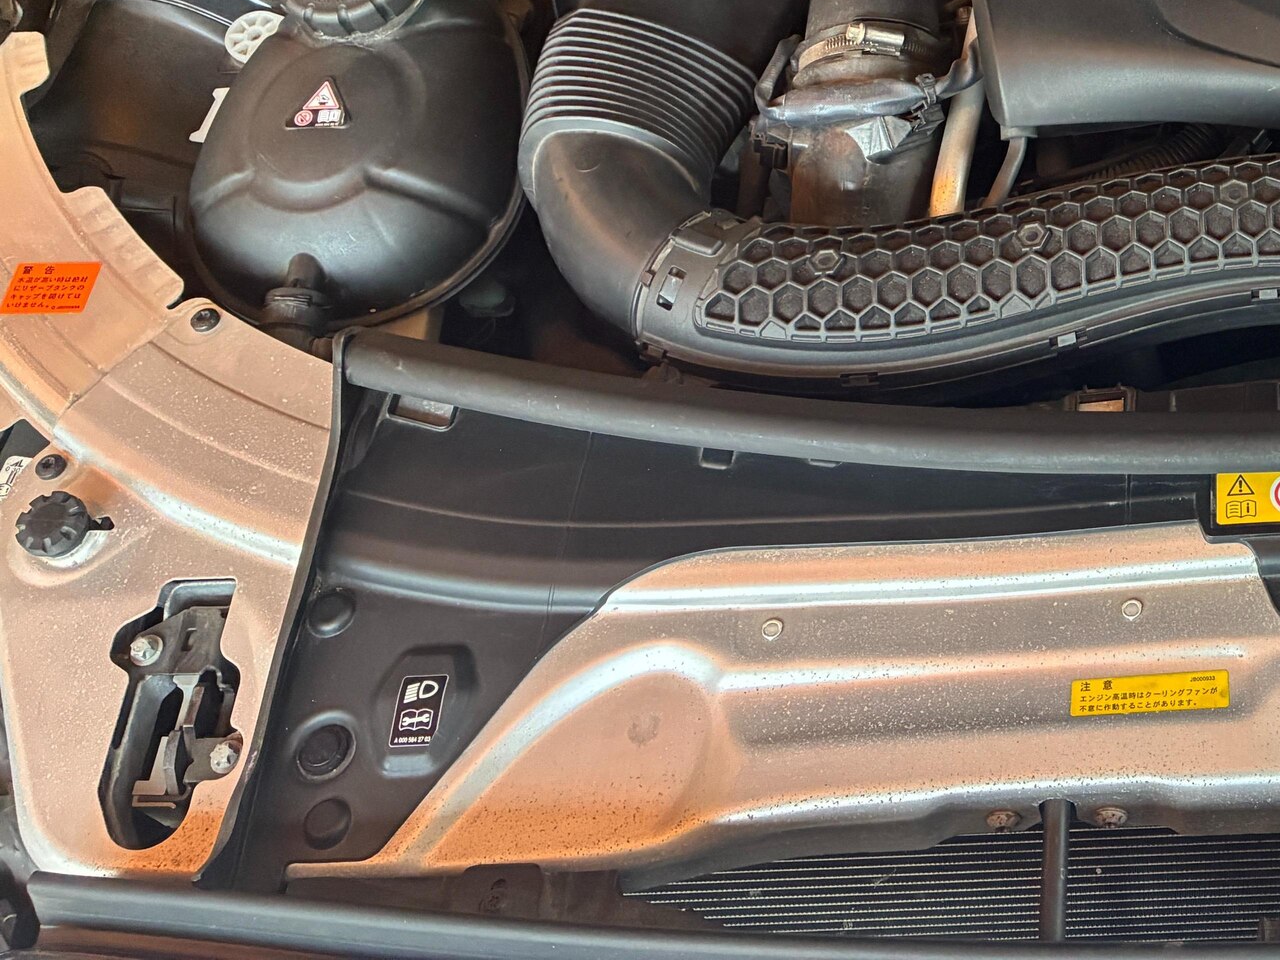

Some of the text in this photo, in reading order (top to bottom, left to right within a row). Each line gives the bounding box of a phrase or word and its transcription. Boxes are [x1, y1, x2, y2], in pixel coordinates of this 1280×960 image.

[1079, 686, 1218, 703] エンジン高温時はクーリングファンが
[1078, 698, 1198, 713] 不意に作動することがあります。
